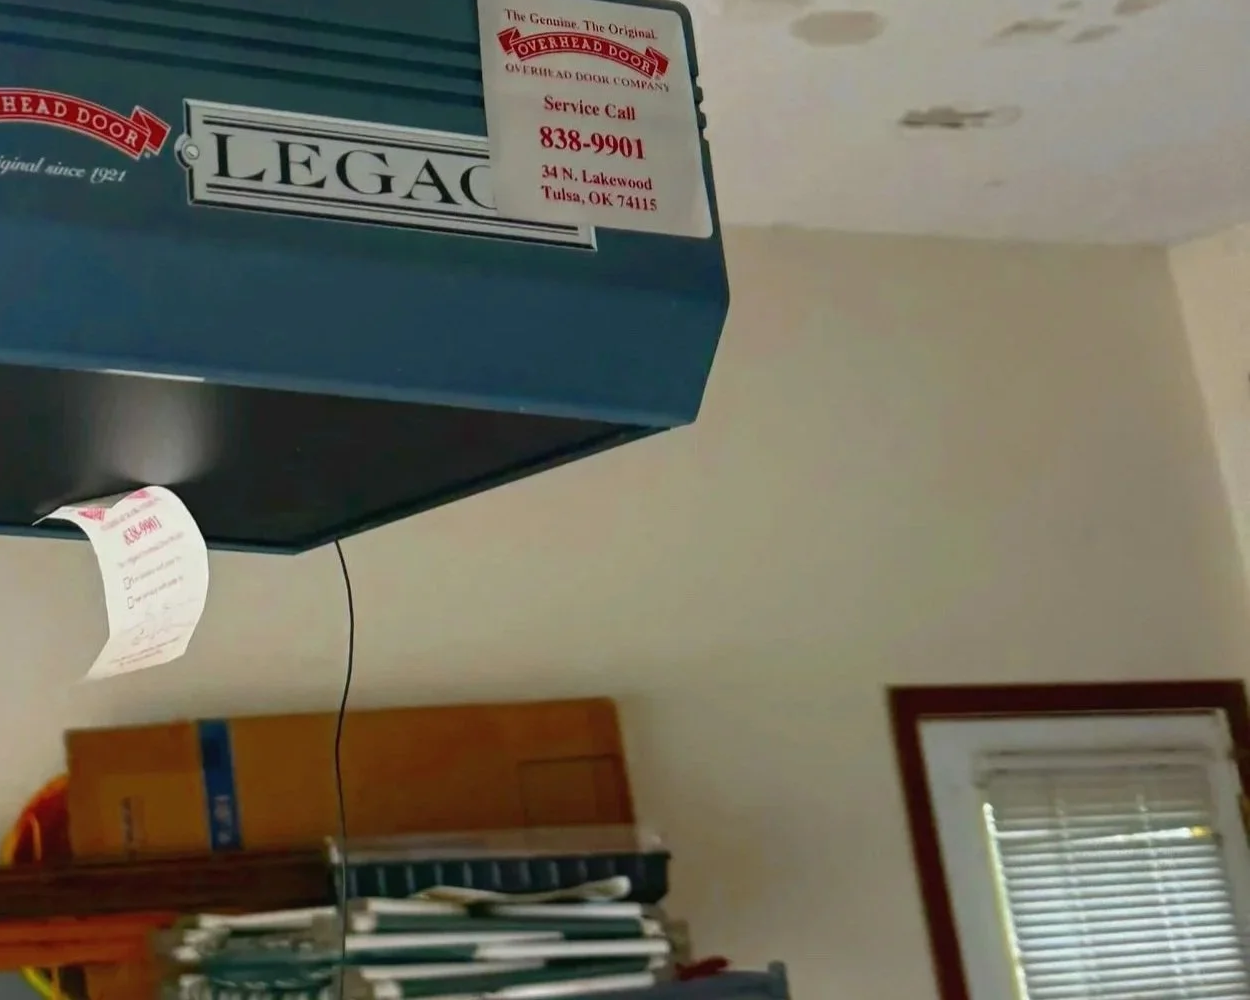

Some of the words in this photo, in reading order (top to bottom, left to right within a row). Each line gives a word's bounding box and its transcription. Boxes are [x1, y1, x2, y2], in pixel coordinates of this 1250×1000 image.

[504, 9, 526, 22] The
[529, 12, 580, 30] Genuine.
[583, 19, 605, 34] The
[608, 23, 658, 41] Original.
[517, 35, 603, 56] OVERHEAD
[608, 45, 652, 74] DOOR
[505, 62, 573, 80] OVERHEAD
[576, 70, 610, 85] DOOR
[613, 77, 670, 93] COMPANY
[544, 94, 600, 117] Service
[604, 103, 636, 121] Call
[76, 106, 140, 148] DOOR
[539, 125, 646, 161] 838-9901
[44, 161, 87, 179] since
[89, 166, 128, 185] 1921
[210, 131, 498, 211] LEGAC
[541, 164, 558, 180] 34
[561, 166, 578, 182] N.
[582, 169, 653, 191] Lakewood
[540, 184, 586, 206] Tulsa,
[588, 190, 614, 207] OK
[617, 194, 658, 212] 74115
